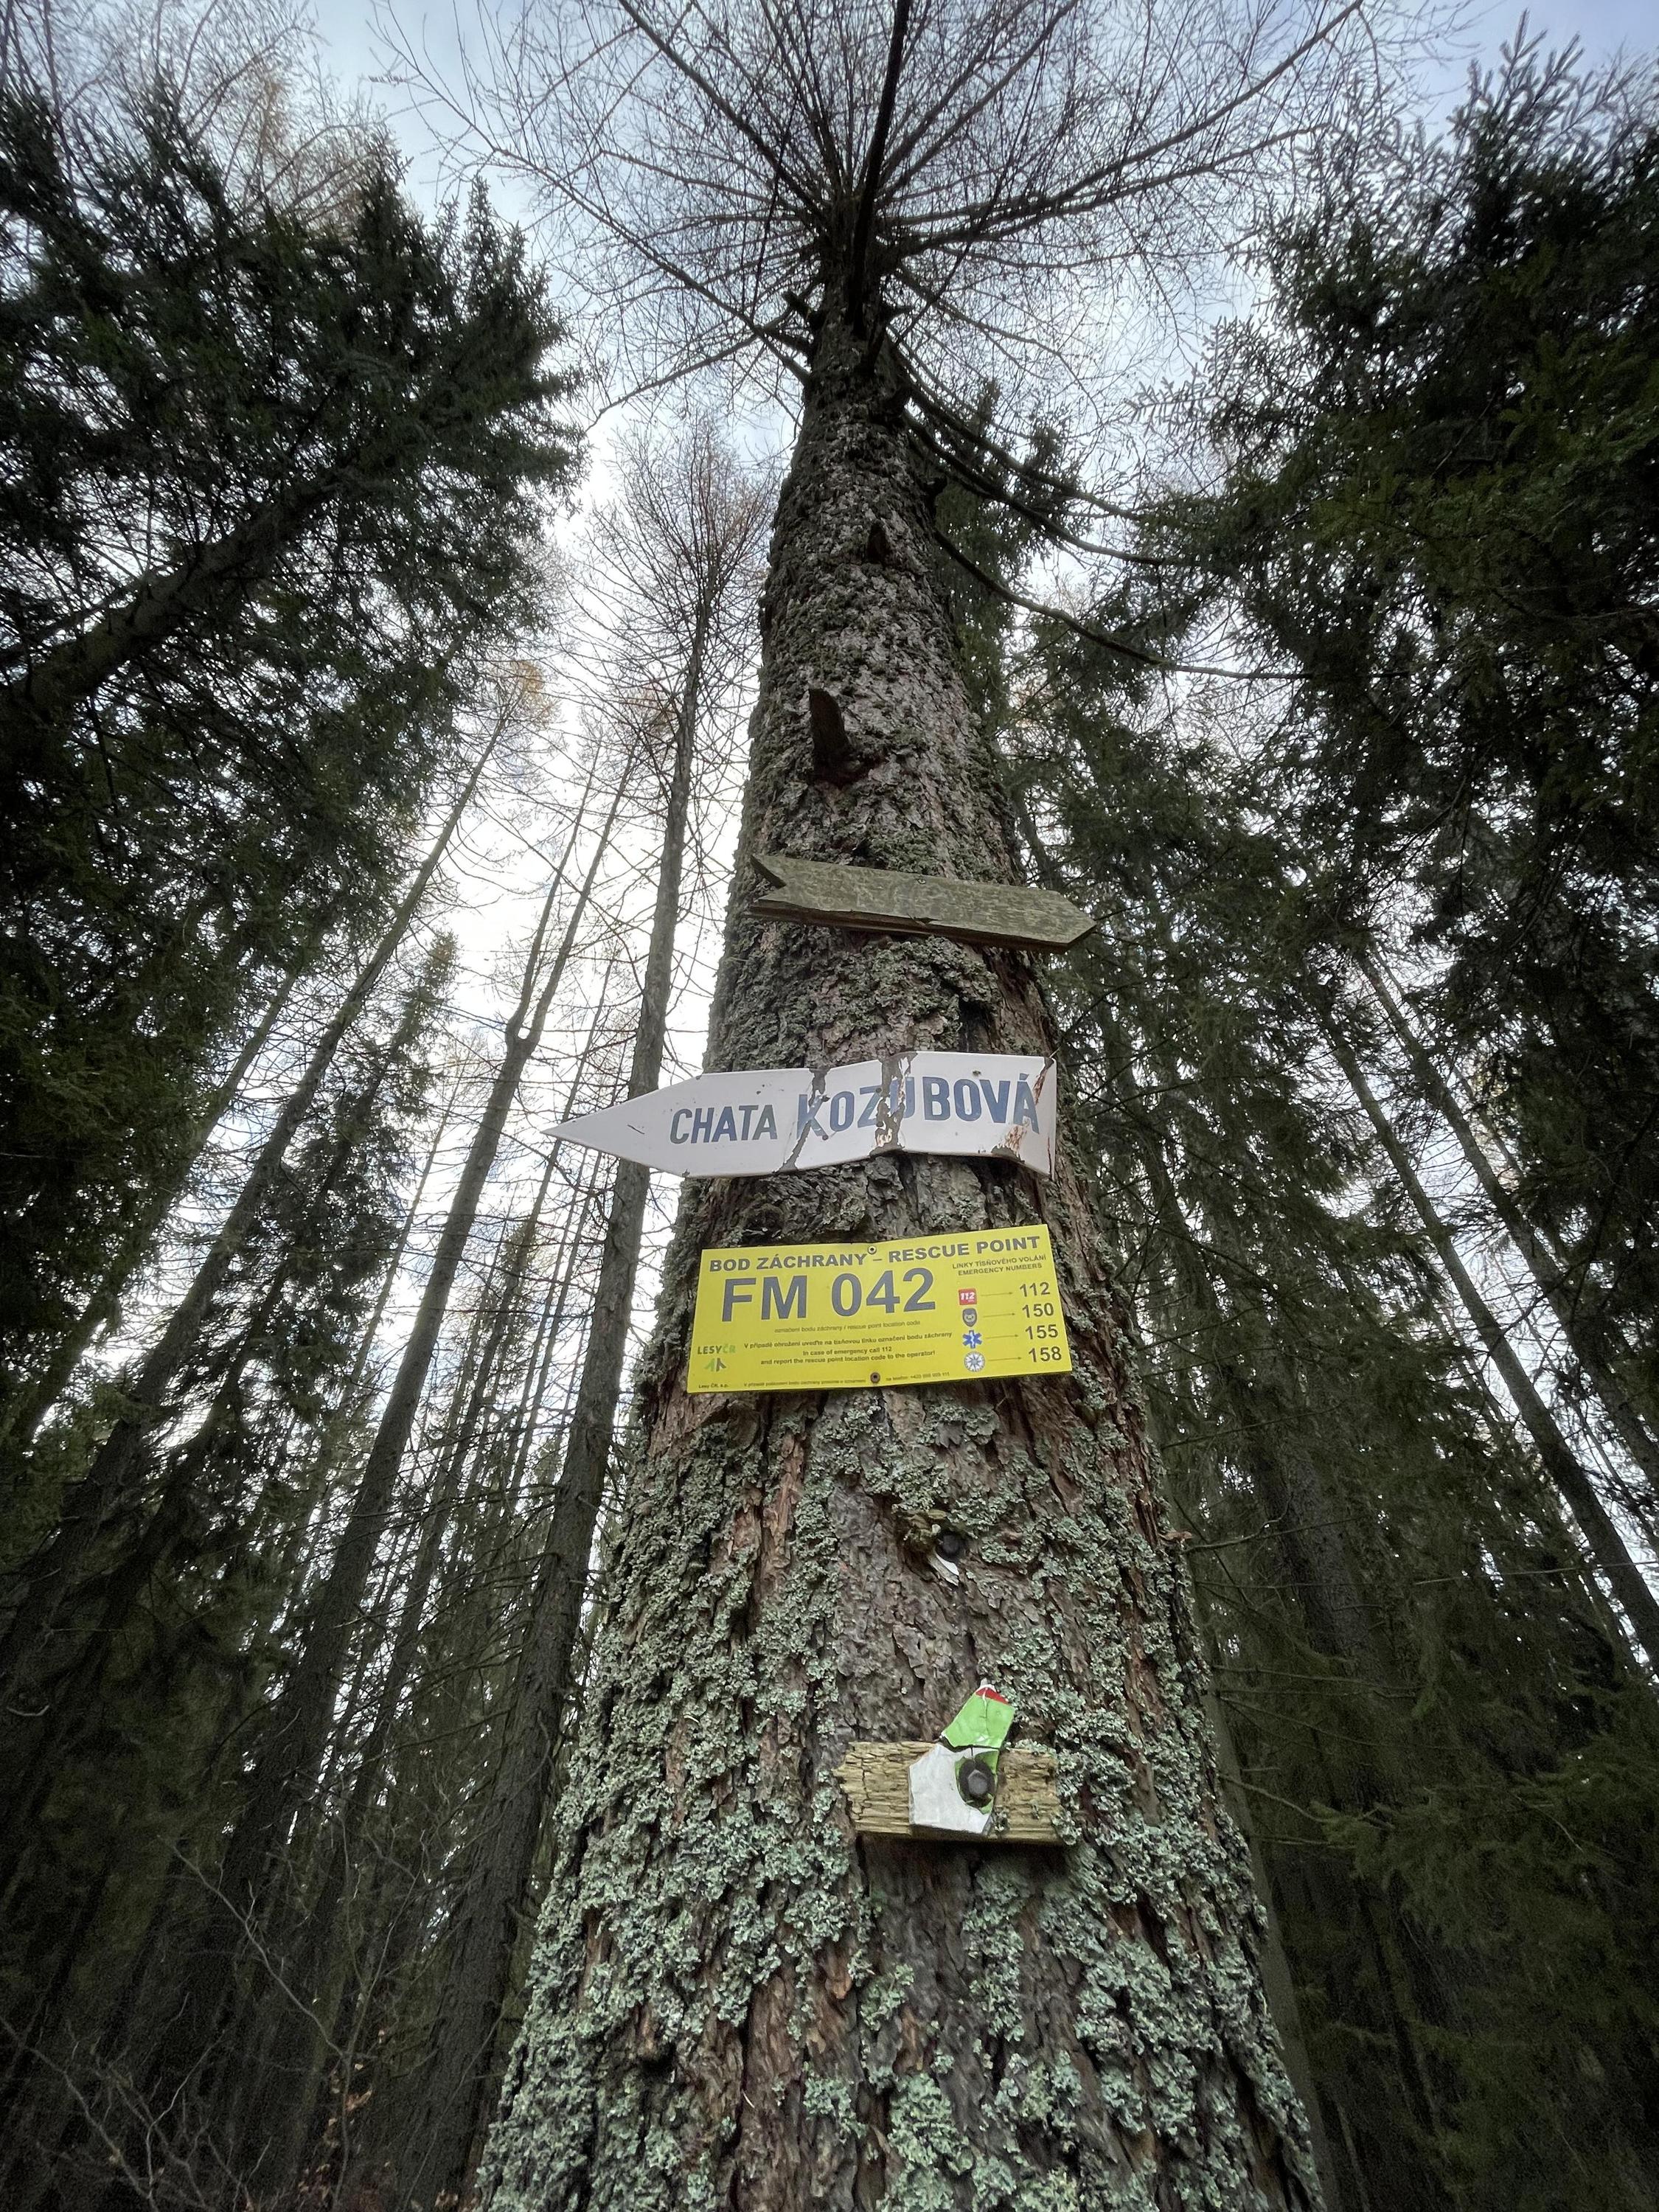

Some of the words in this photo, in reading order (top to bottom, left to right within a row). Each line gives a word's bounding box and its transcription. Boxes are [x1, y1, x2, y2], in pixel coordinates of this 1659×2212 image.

[669, 1104, 777, 1144] CHATA
[796, 1073, 1040, 1139] KOZUBOVÁ
[709, 1259, 750, 1272] BOD
[757, 1253, 868, 1270] ZÁCHRANY
[888, 1243, 970, 1263] RESCUE
[976, 1236, 1040, 1253] POINT
[959, 1267, 1004, 1276] EMERGENCY
[1006, 1262, 1043, 1271] NUMBERS
[722, 1275, 808, 1322] FM
[832, 1267, 936, 1317] 042
[960, 1292, 975, 1300] 112
[1020, 1281, 1051, 1298] 112
[1022, 1302, 1054, 1318] 150
[1025, 1324, 1059, 1340] 155
[1029, 1346, 1062, 1363] 158
